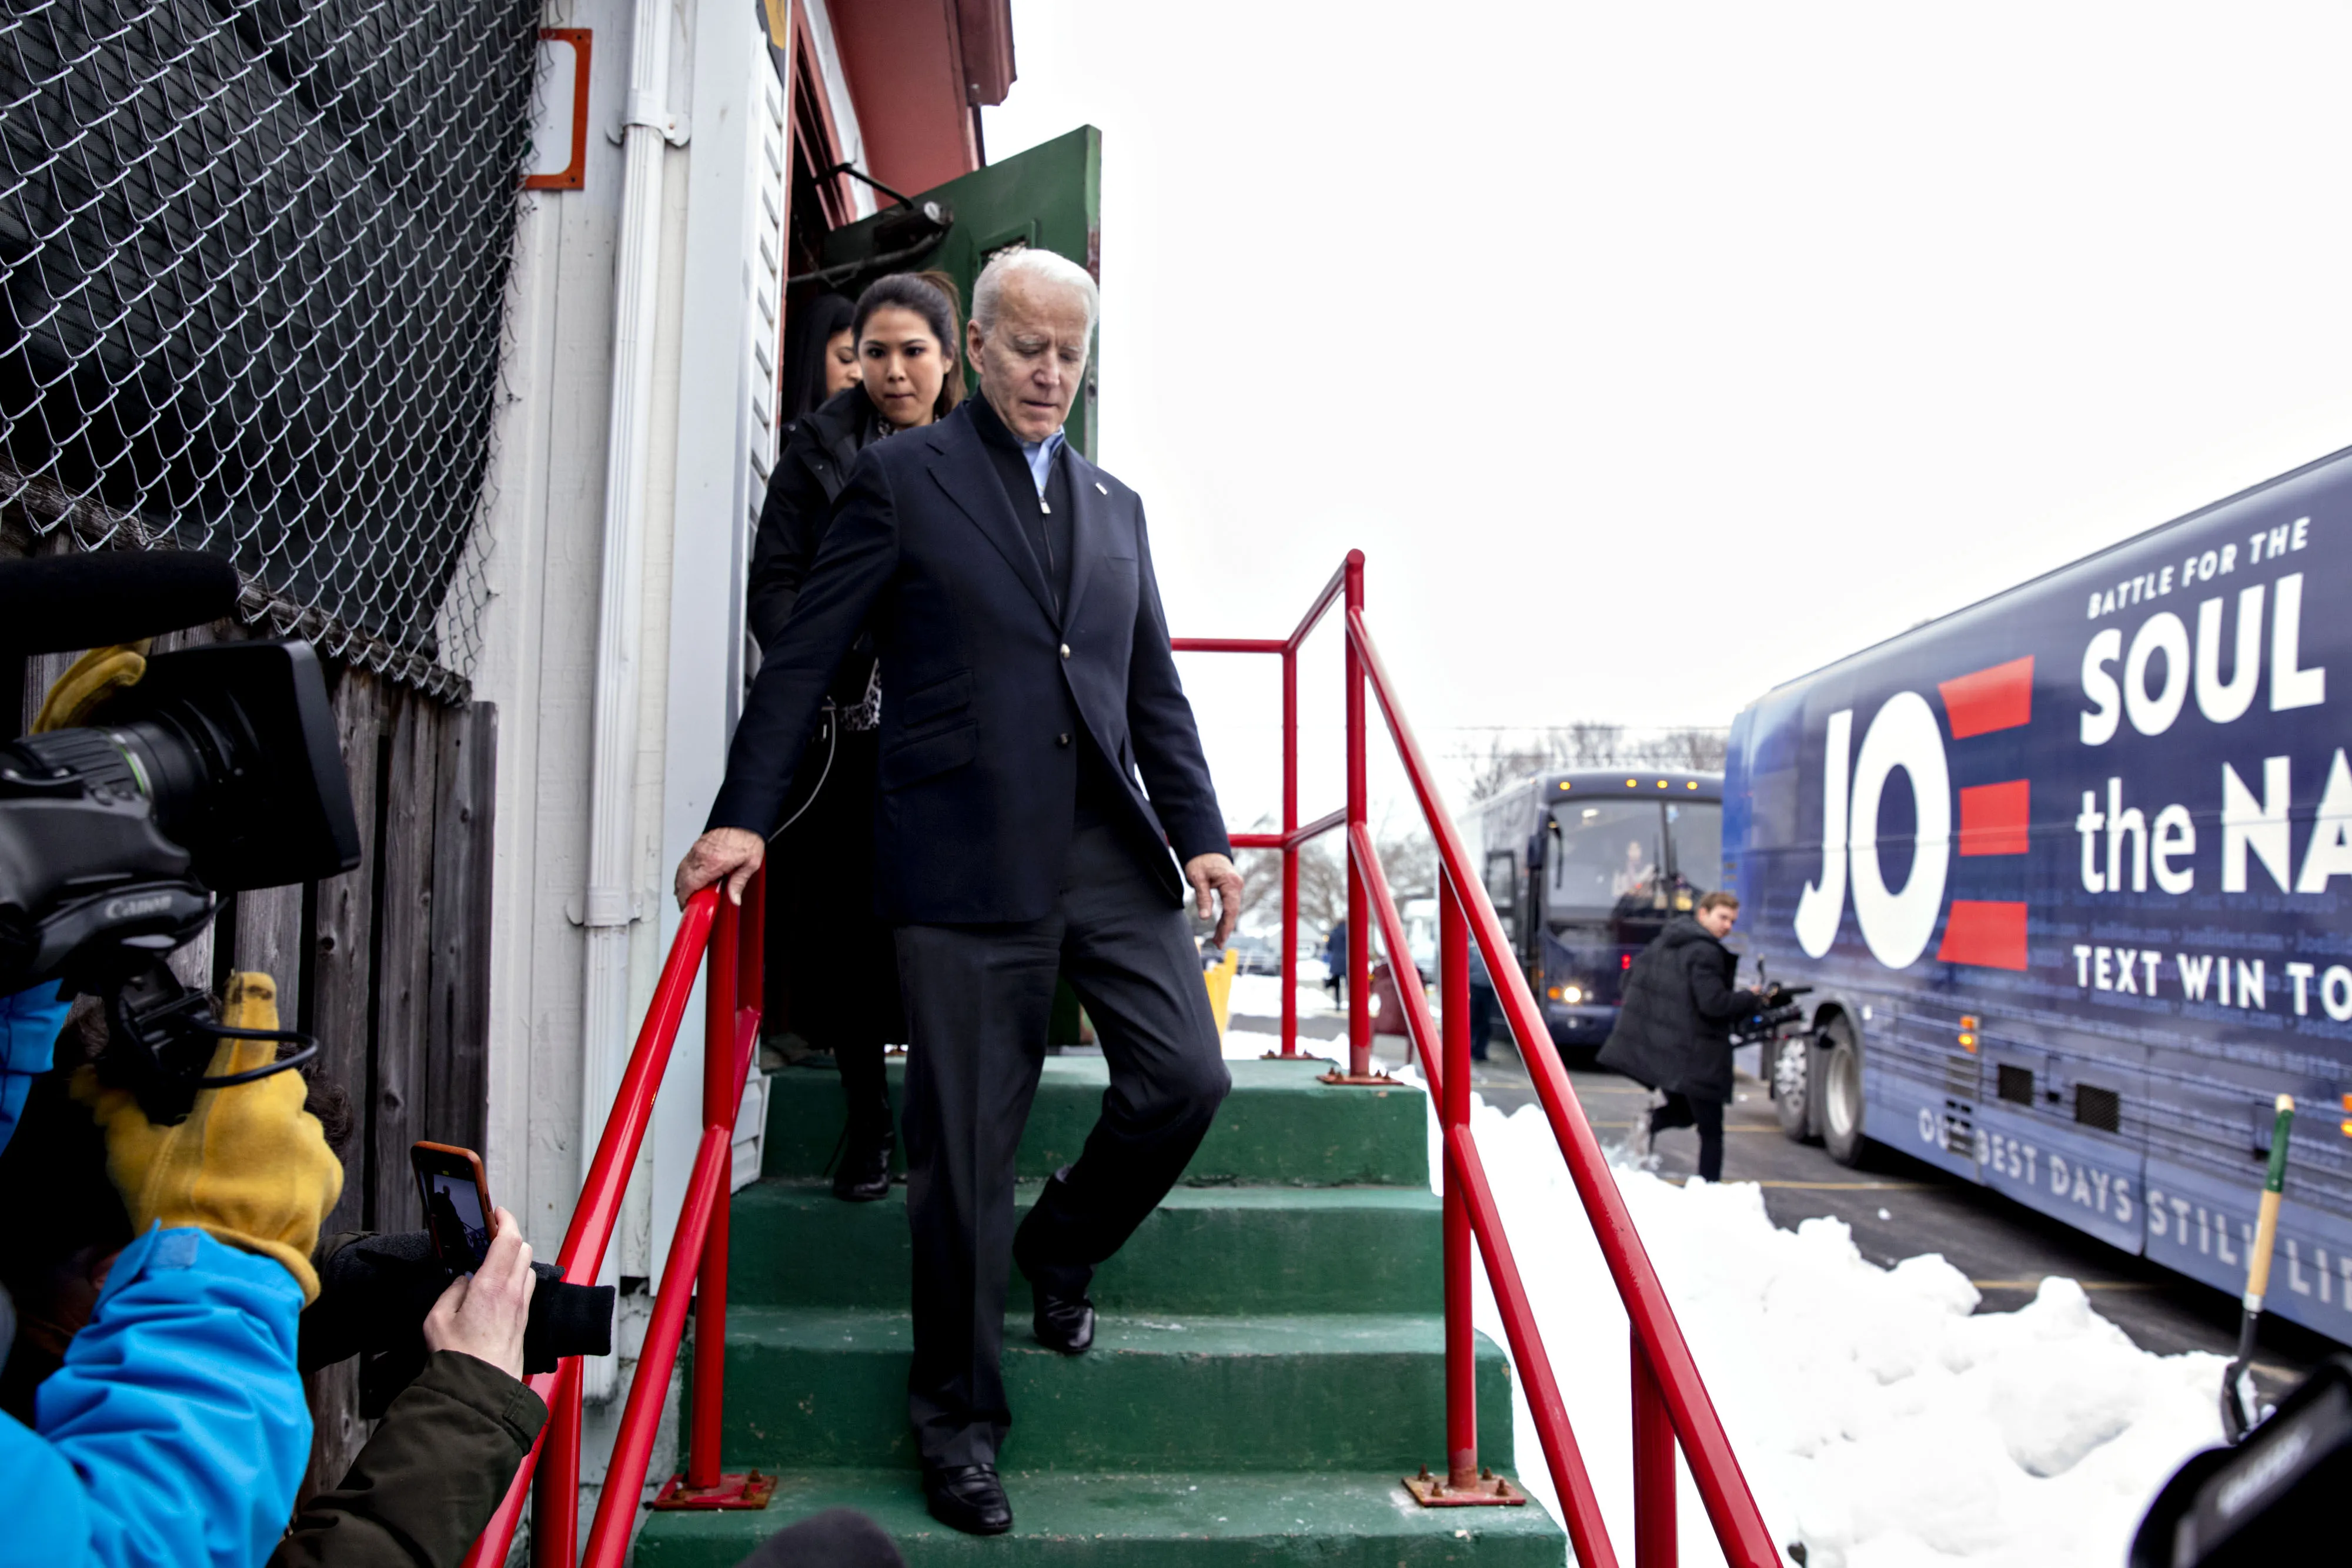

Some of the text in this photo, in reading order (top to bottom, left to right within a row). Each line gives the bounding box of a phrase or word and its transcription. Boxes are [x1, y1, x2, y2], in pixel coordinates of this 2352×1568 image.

[2087, 516, 2311, 620] BATTLE FOR THE
[2080, 573, 2326, 746] SOUL
[1793, 654, 2034, 971] JOE
[2075, 777, 2196, 895] the
[105, 896, 172, 919] Canon
[2073, 944, 2163, 997] TEXT
[2176, 952, 2266, 1010] WIN
[2285, 961, 2352, 1022] TO
[1976, 1128, 2038, 1186] BEST
[2050, 1155, 2133, 1222] DAYS
